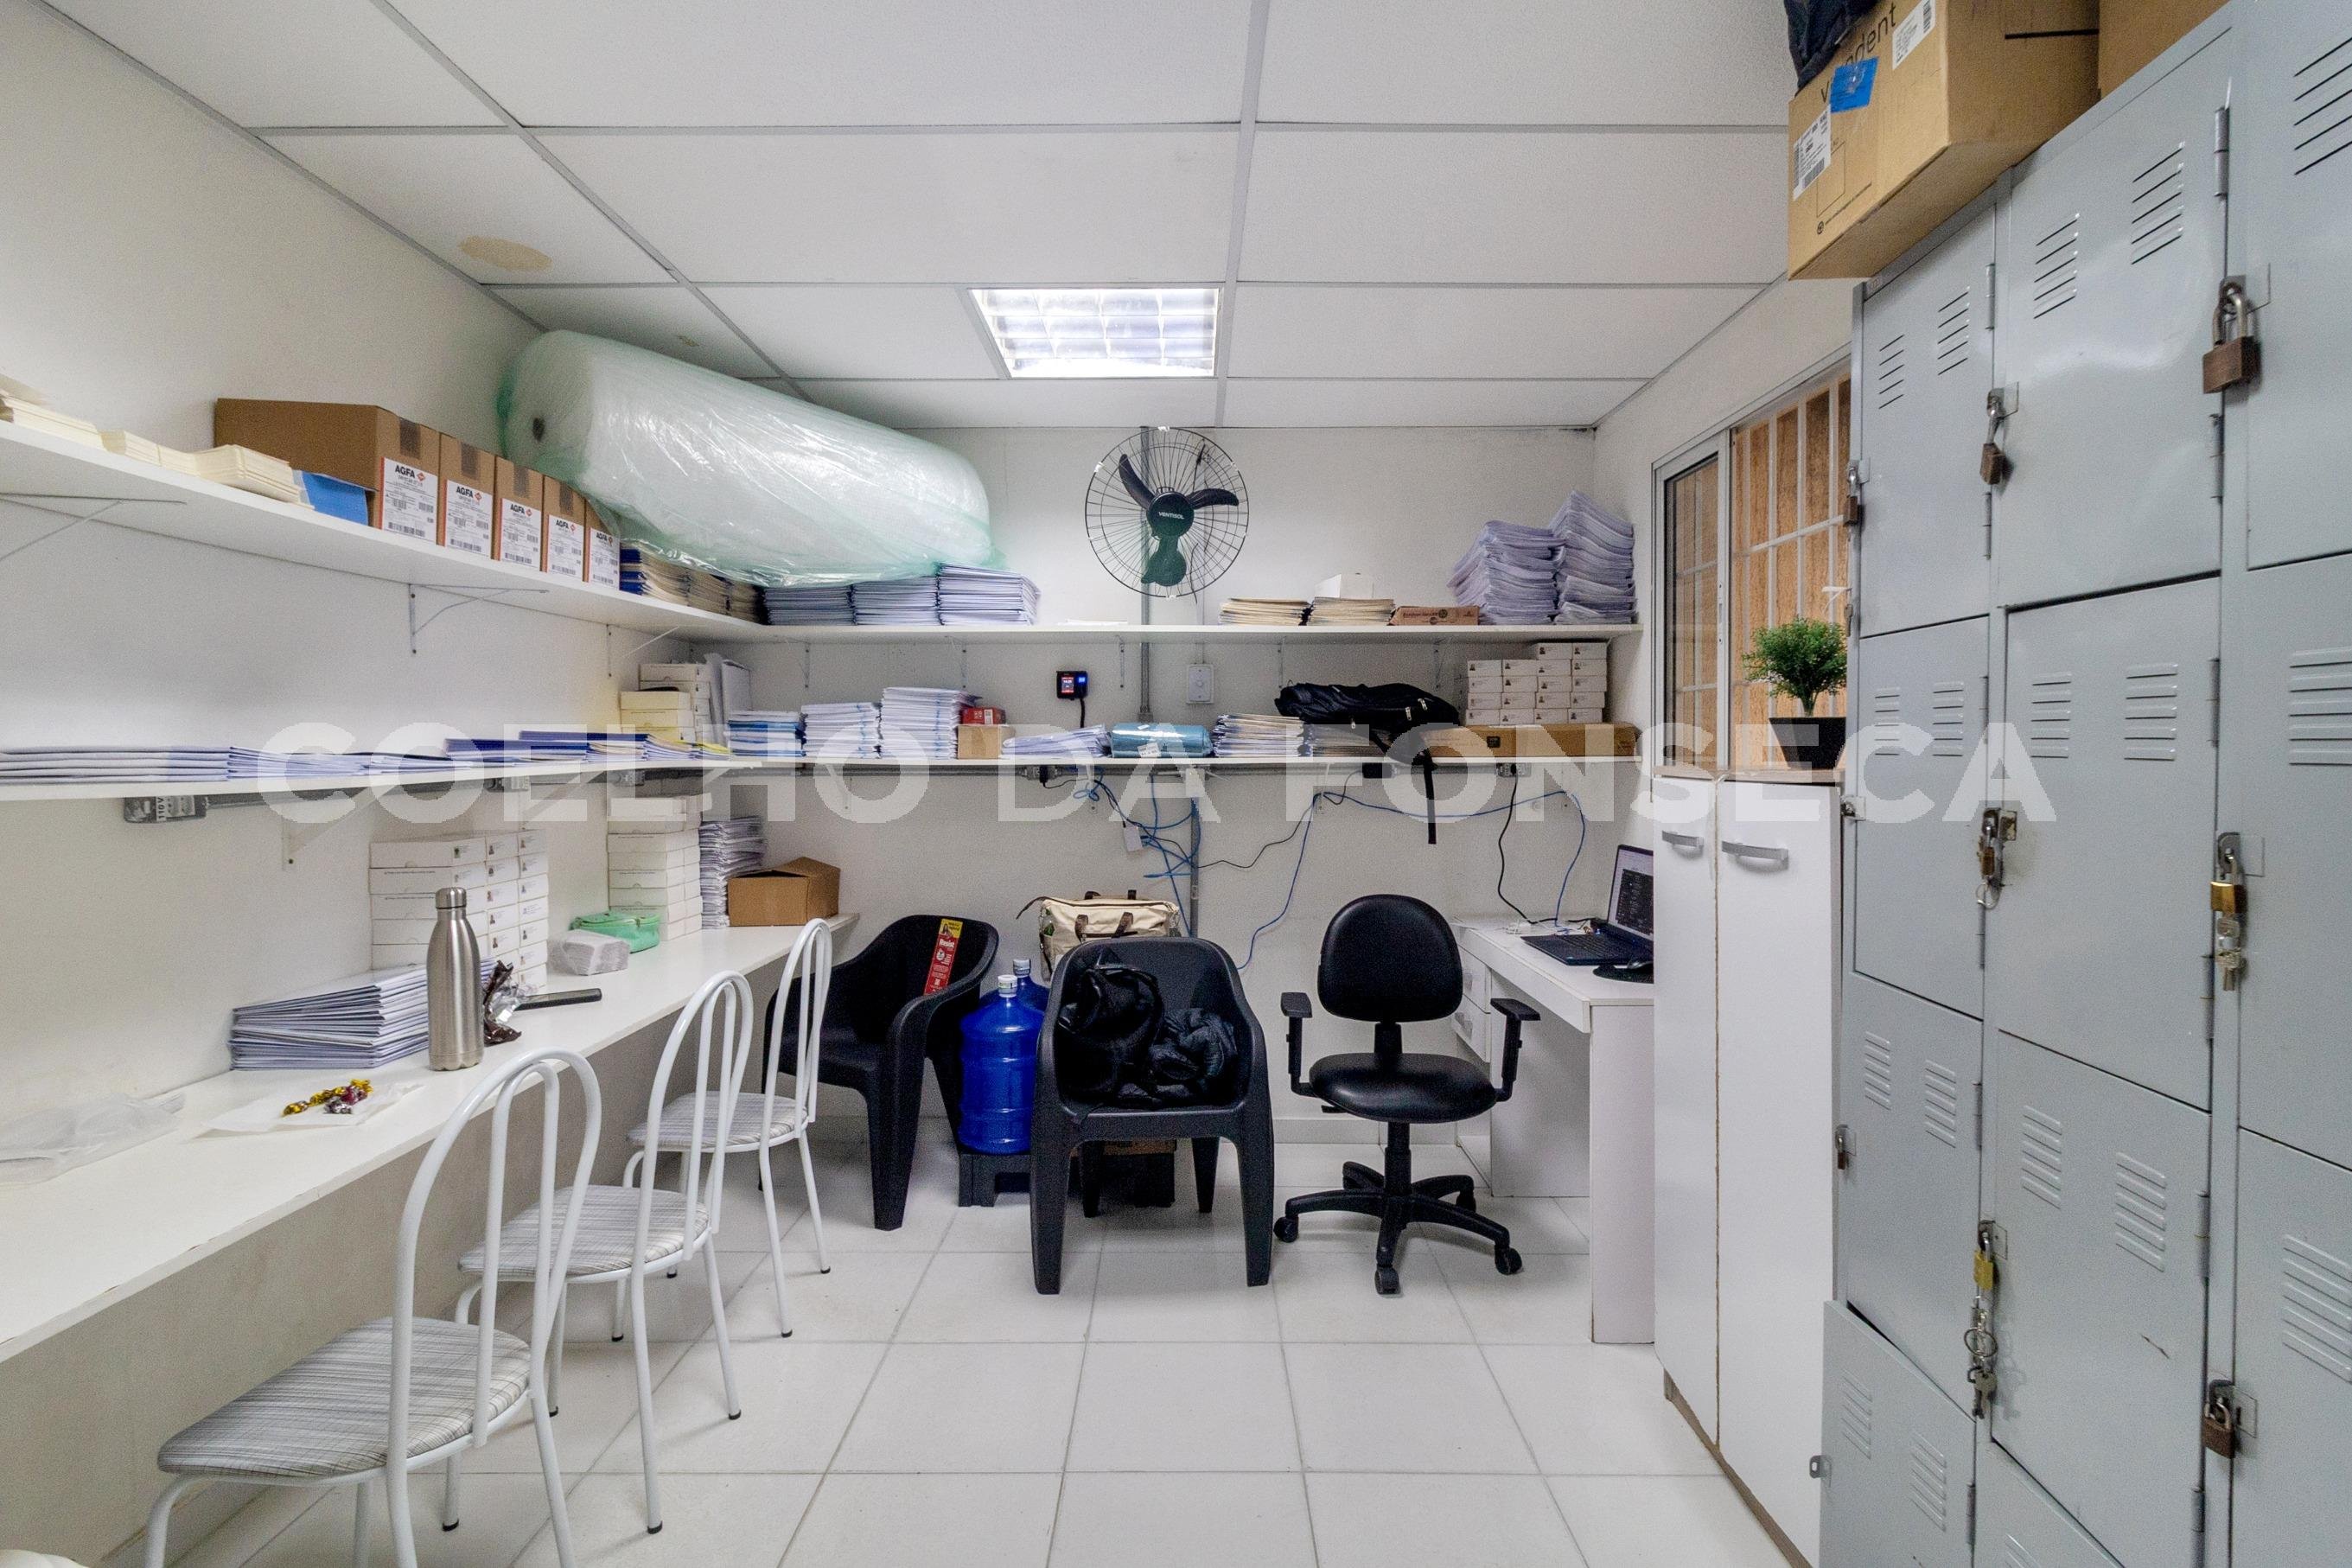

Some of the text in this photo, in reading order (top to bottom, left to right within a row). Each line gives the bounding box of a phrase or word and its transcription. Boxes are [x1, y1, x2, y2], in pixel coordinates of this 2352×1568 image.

[395, 465, 415, 479] AGFA
[456, 486, 474, 499] AGFA
[510, 503, 525, 514] AGFA
[556, 519, 570, 530] AGFA
